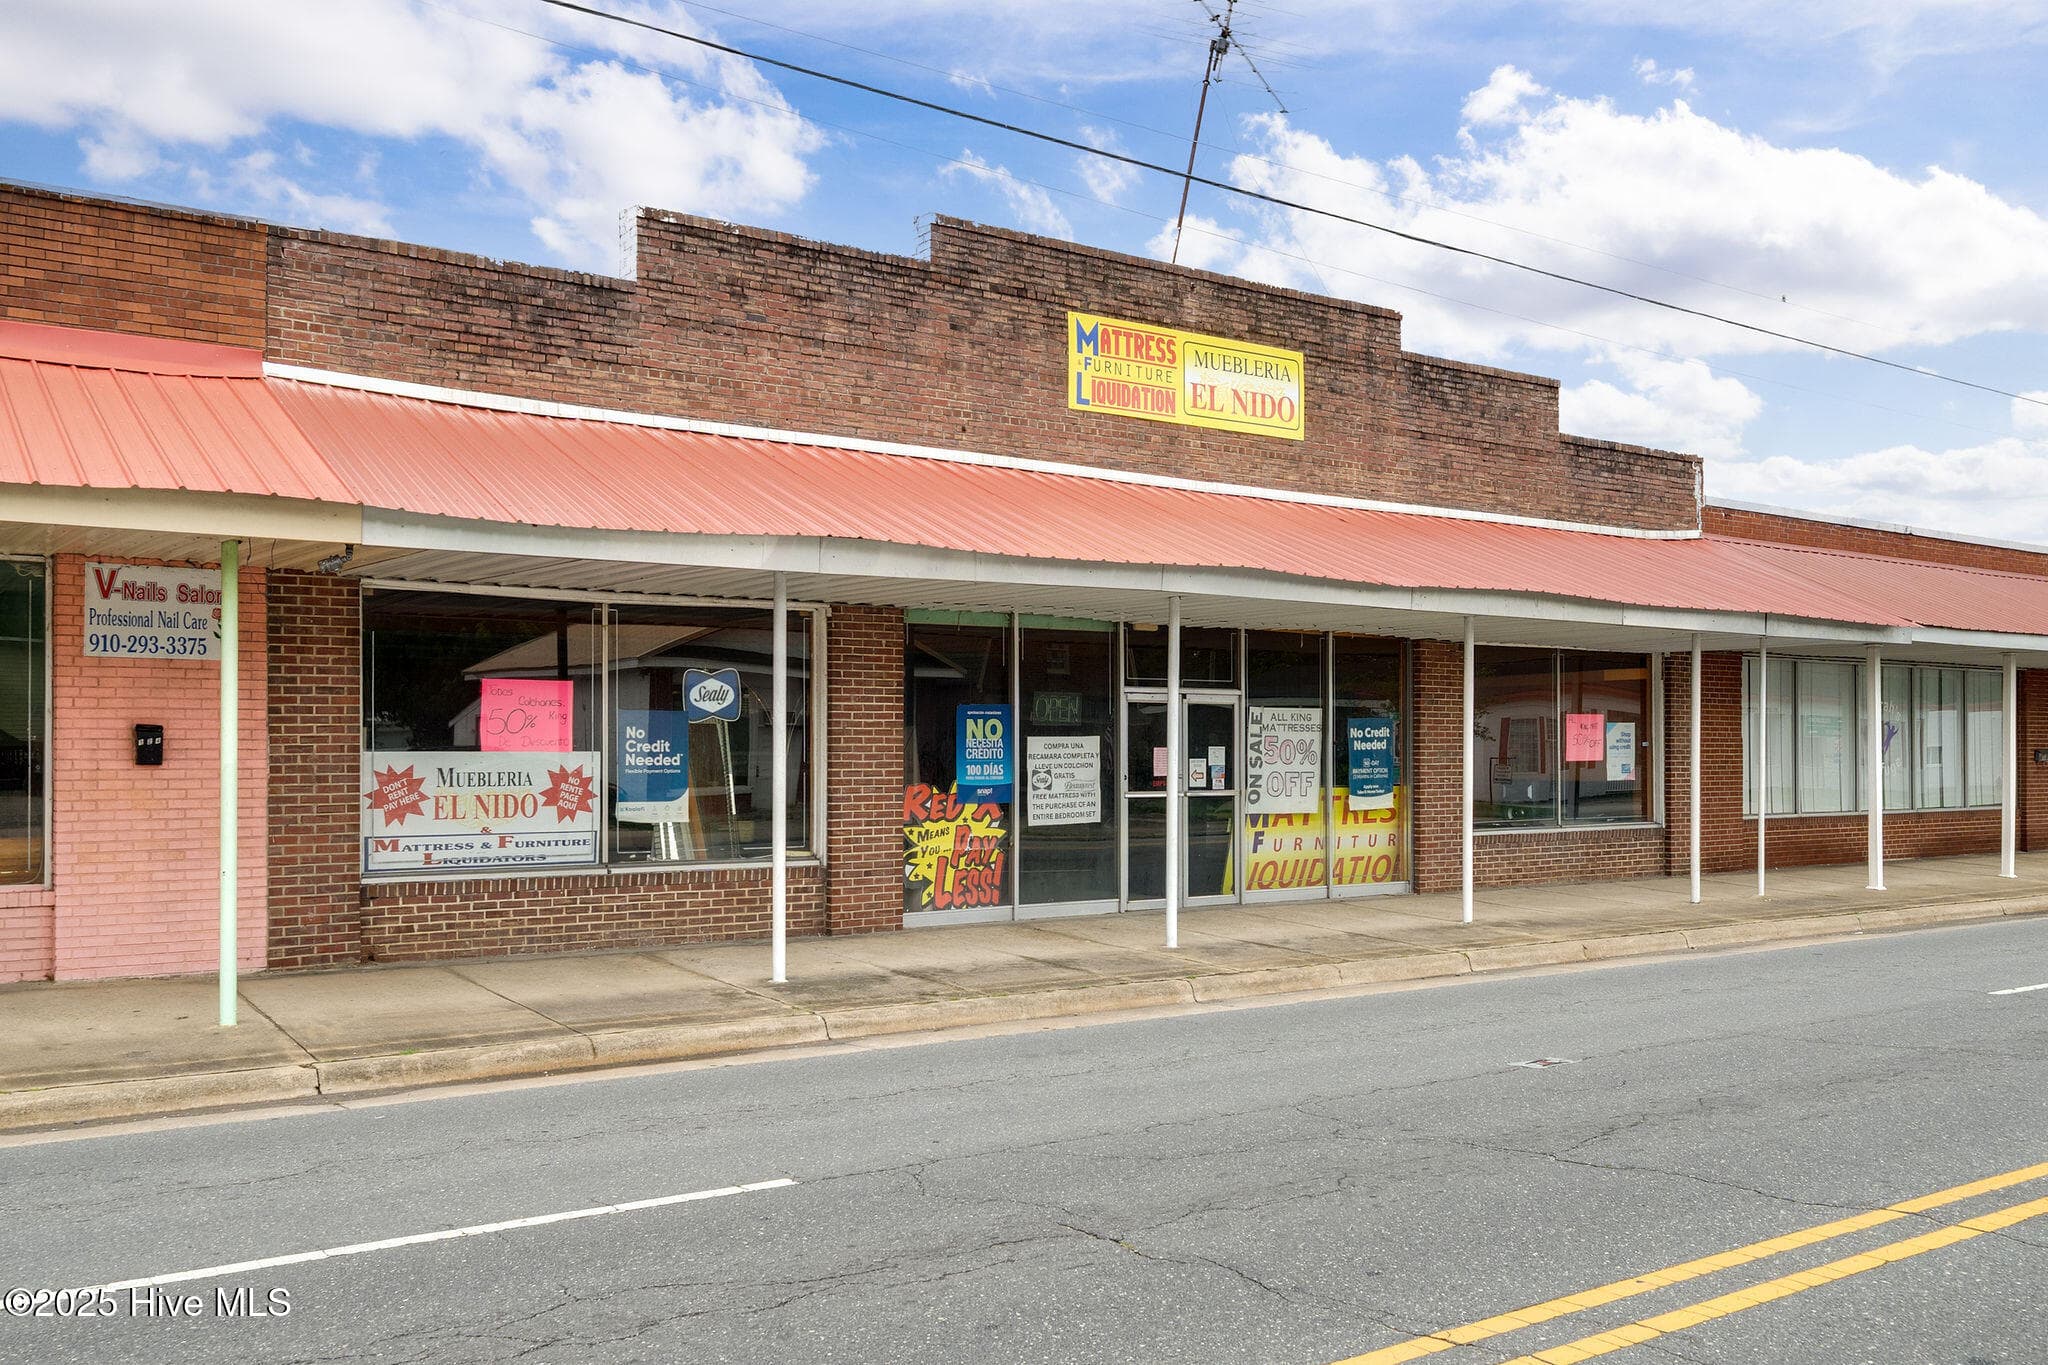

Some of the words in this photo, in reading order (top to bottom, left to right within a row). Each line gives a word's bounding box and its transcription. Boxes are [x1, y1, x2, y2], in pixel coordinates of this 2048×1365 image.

[1076, 317, 1177, 364] MATTRESS
[1085, 357, 1173, 383] FURNITURE
[1194, 350, 1291, 382] MUEBLERIA
[1077, 372, 1176, 414] LIQUIDATION
[1191, 382, 1224, 412] EL
[1231, 389, 1295, 422] NIDO
[94, 568, 167, 601] V-Nails
[89, 608, 153, 628] Professional
[158, 611, 179, 629] Nail
[183, 612, 208, 629] Care
[89, 633, 207, 655] 910-293-3375
[694, 685, 729, 705] Sealy
[1036, 695, 1079, 721] OPEN
[1271, 713, 1287, 721] ALL
[1290, 713, 1312, 721] KING
[486, 708, 538, 735] 50%
[966, 718, 1003, 740] NO
[1262, 723, 1322, 732] MATTRESSES
[626, 726, 645, 739] No
[1250, 712, 1263, 769] SALE
[1350, 727, 1363, 738] No
[1364, 726, 1390, 738] Credit
[625, 740, 670, 752] Credit
[966, 738, 1003, 749] NECESITA
[1264, 735, 1318, 765] 50%
[1353, 739, 1387, 751] Needed
[436, 768, 533, 788] MUEBLERIA
[966, 764, 981, 775] 100
[983, 763, 1004, 775] DÍAS
[383, 778, 408, 793] DON'T
[560, 783, 584, 796] RENTE
[568, 776, 580, 785] NO
[1248, 774, 1262, 804] ON
[1266, 771, 1315, 797] OFF
[383, 801, 399, 812] PAY
[400, 792, 420, 806] HERE
[388, 787, 409, 801] RENT
[560, 791, 580, 803] PAGE
[433, 795, 467, 820] EL
[474, 793, 539, 819] NIDO
[1055, 811, 1086, 819] BEDROOM
[373, 839, 475, 853] MATTRESS
[480, 842, 494, 850] &
[497, 835, 591, 849] FURNITURE
[917, 826, 950, 843] MEANS
[951, 824, 998, 868] PAY
[422, 853, 547, 866] LIQUIDATORS
[934, 852, 1004, 908] LESS!
